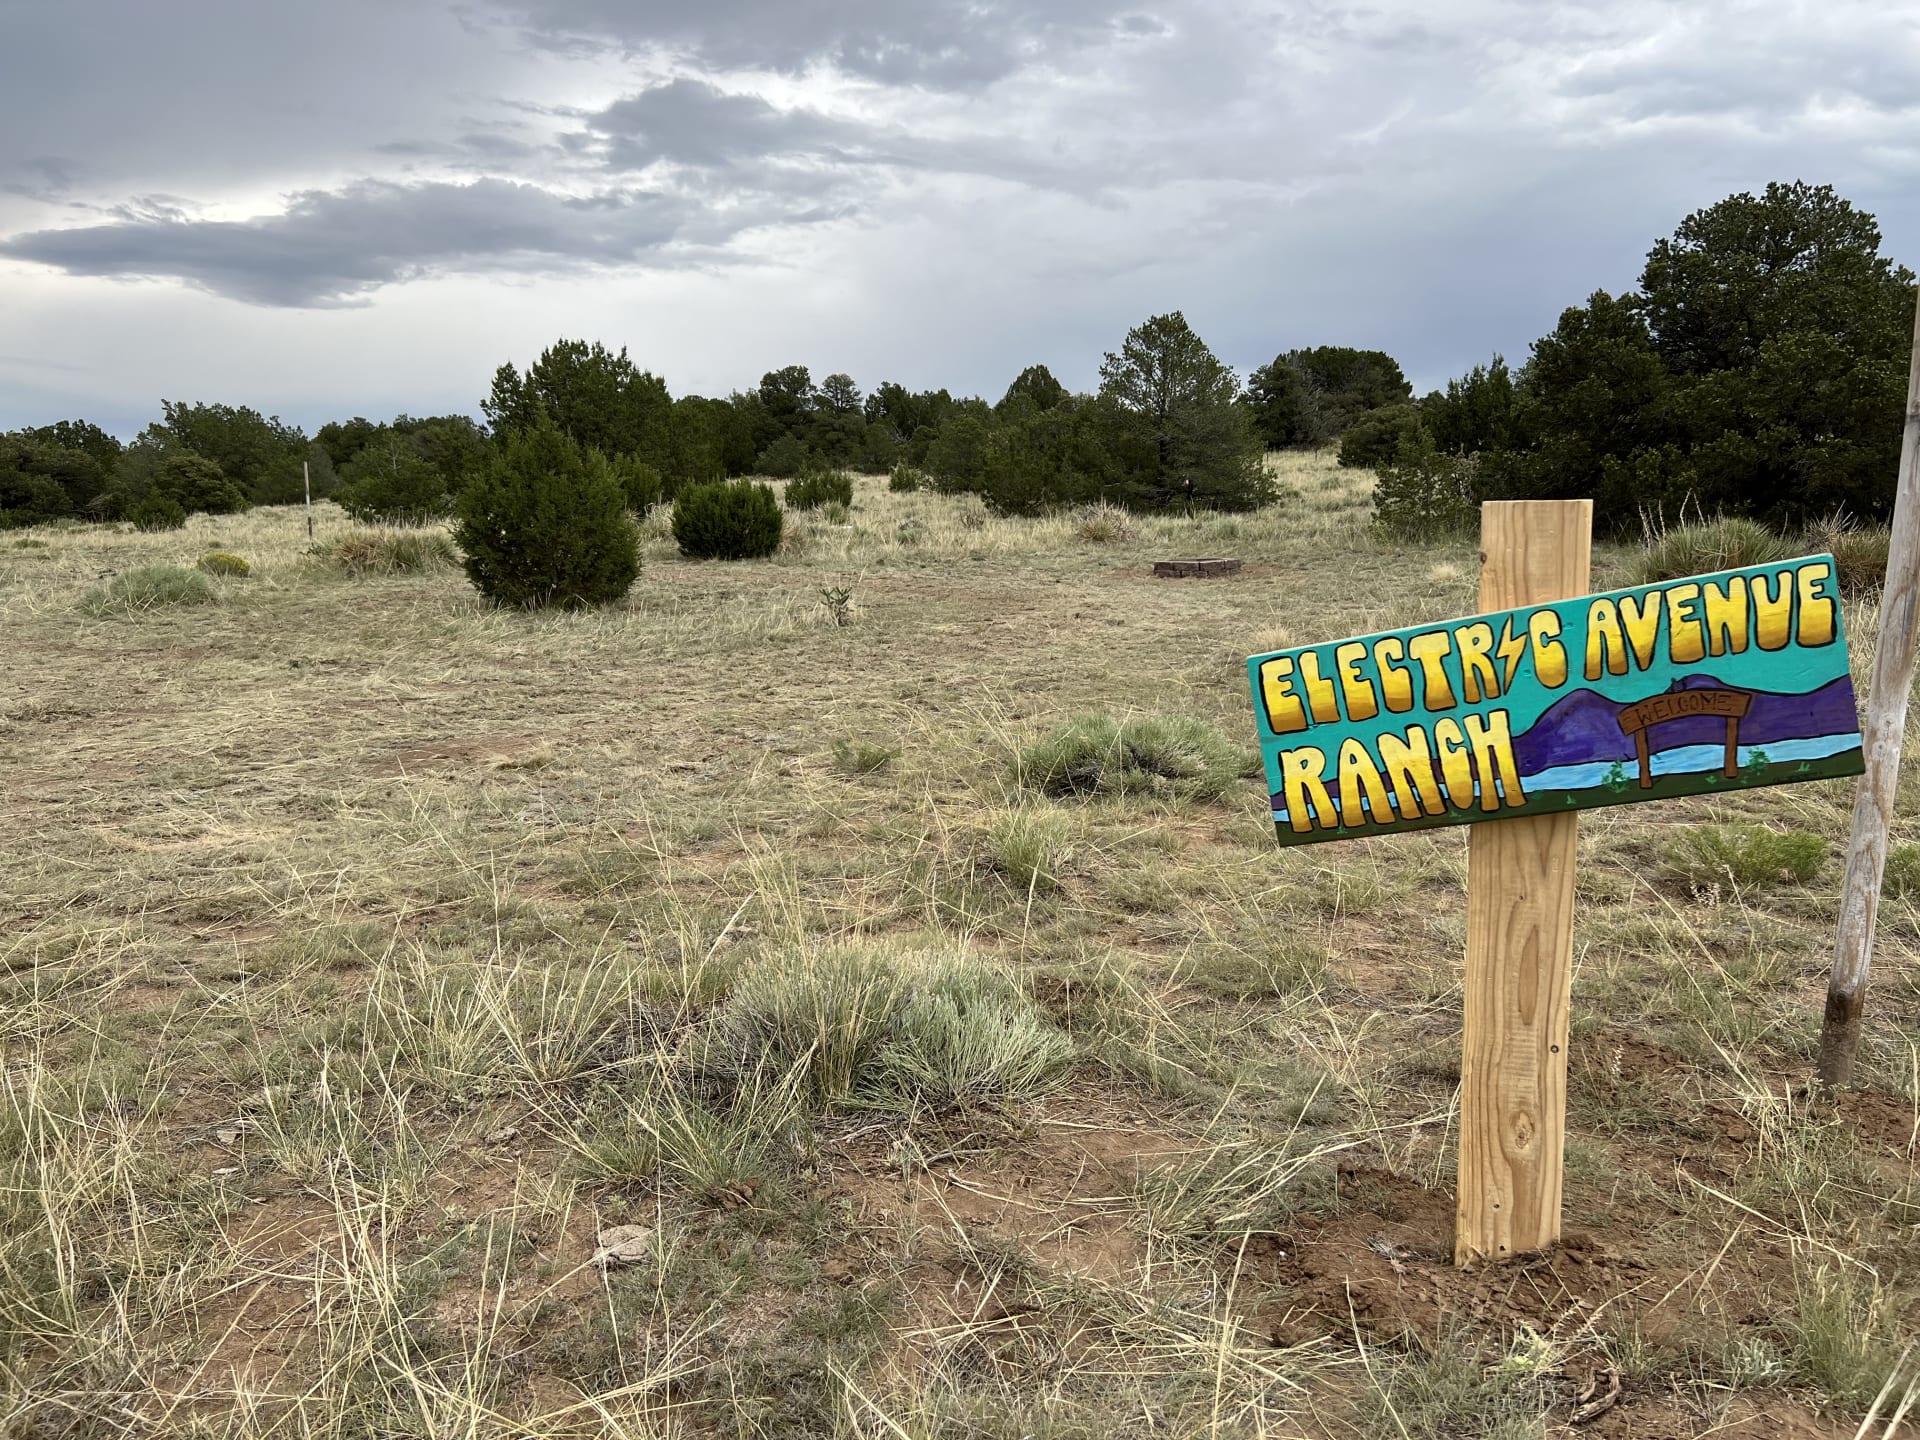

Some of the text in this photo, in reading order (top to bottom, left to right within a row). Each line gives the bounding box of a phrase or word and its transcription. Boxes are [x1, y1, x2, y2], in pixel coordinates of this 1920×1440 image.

[1259, 562, 1837, 735] ELECTRIC AVENUE
[1635, 692, 1732, 725] WELCOME
[1279, 709, 1527, 834] RANCH
